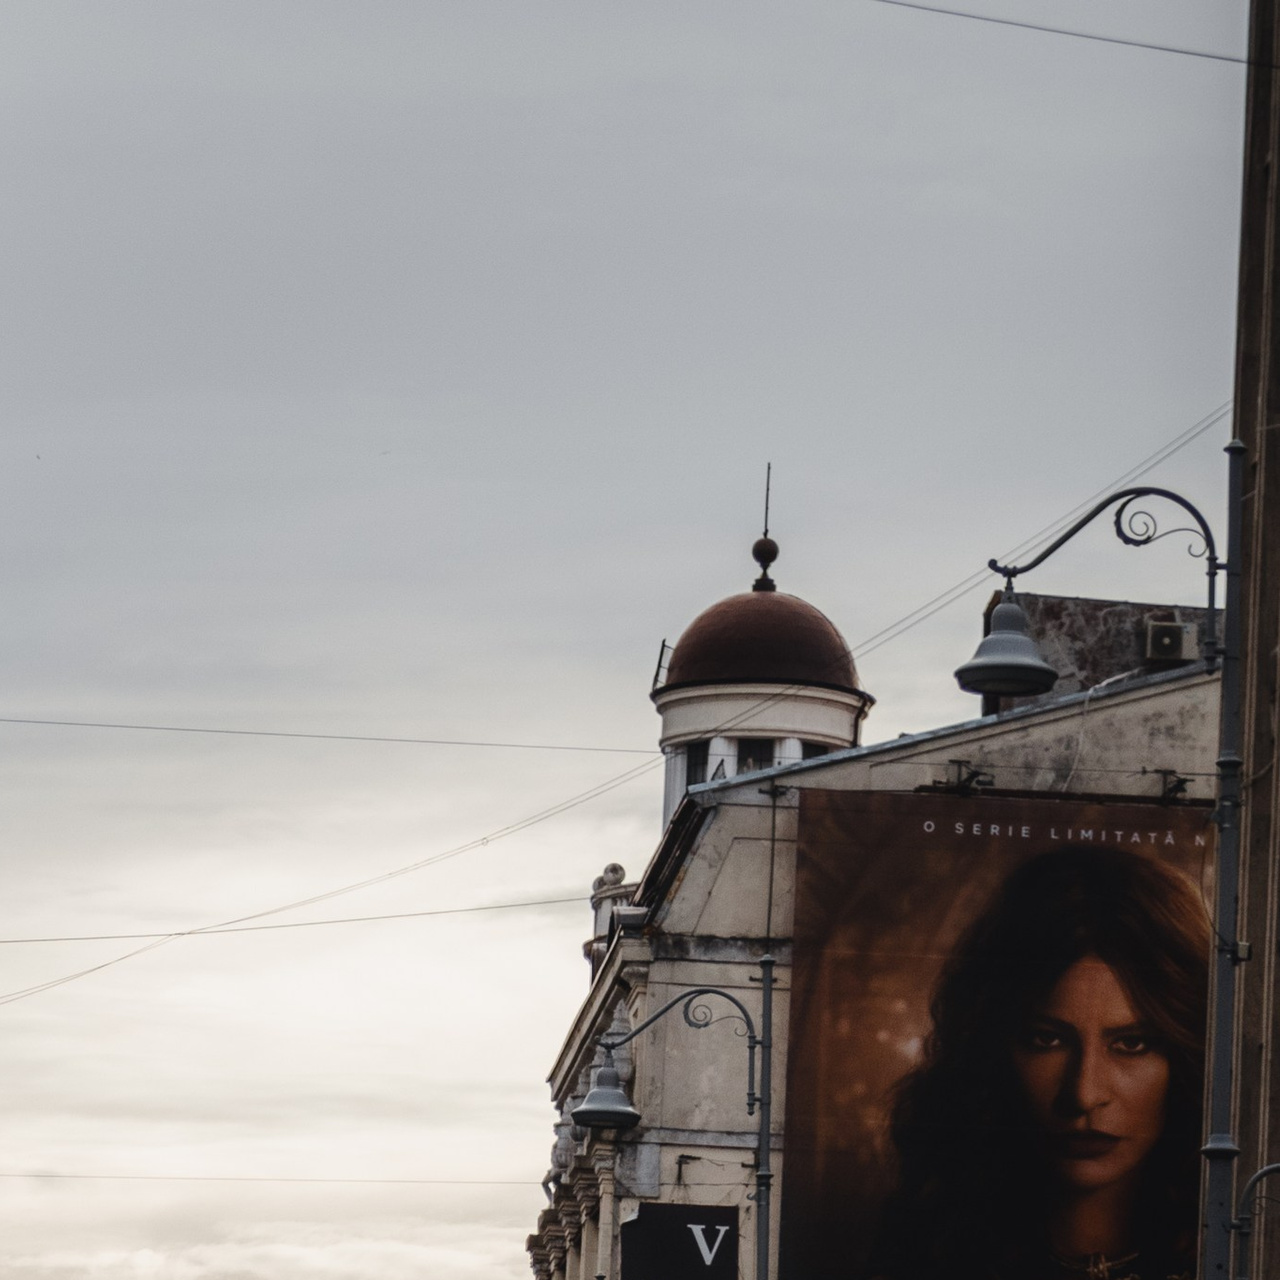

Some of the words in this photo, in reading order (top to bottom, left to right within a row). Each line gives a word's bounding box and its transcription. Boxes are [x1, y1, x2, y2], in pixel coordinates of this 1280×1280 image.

[923, 821, 935, 832] O
[954, 822, 1031, 839] SERIE
[1050, 828, 1175, 846] LIMITATĂ
